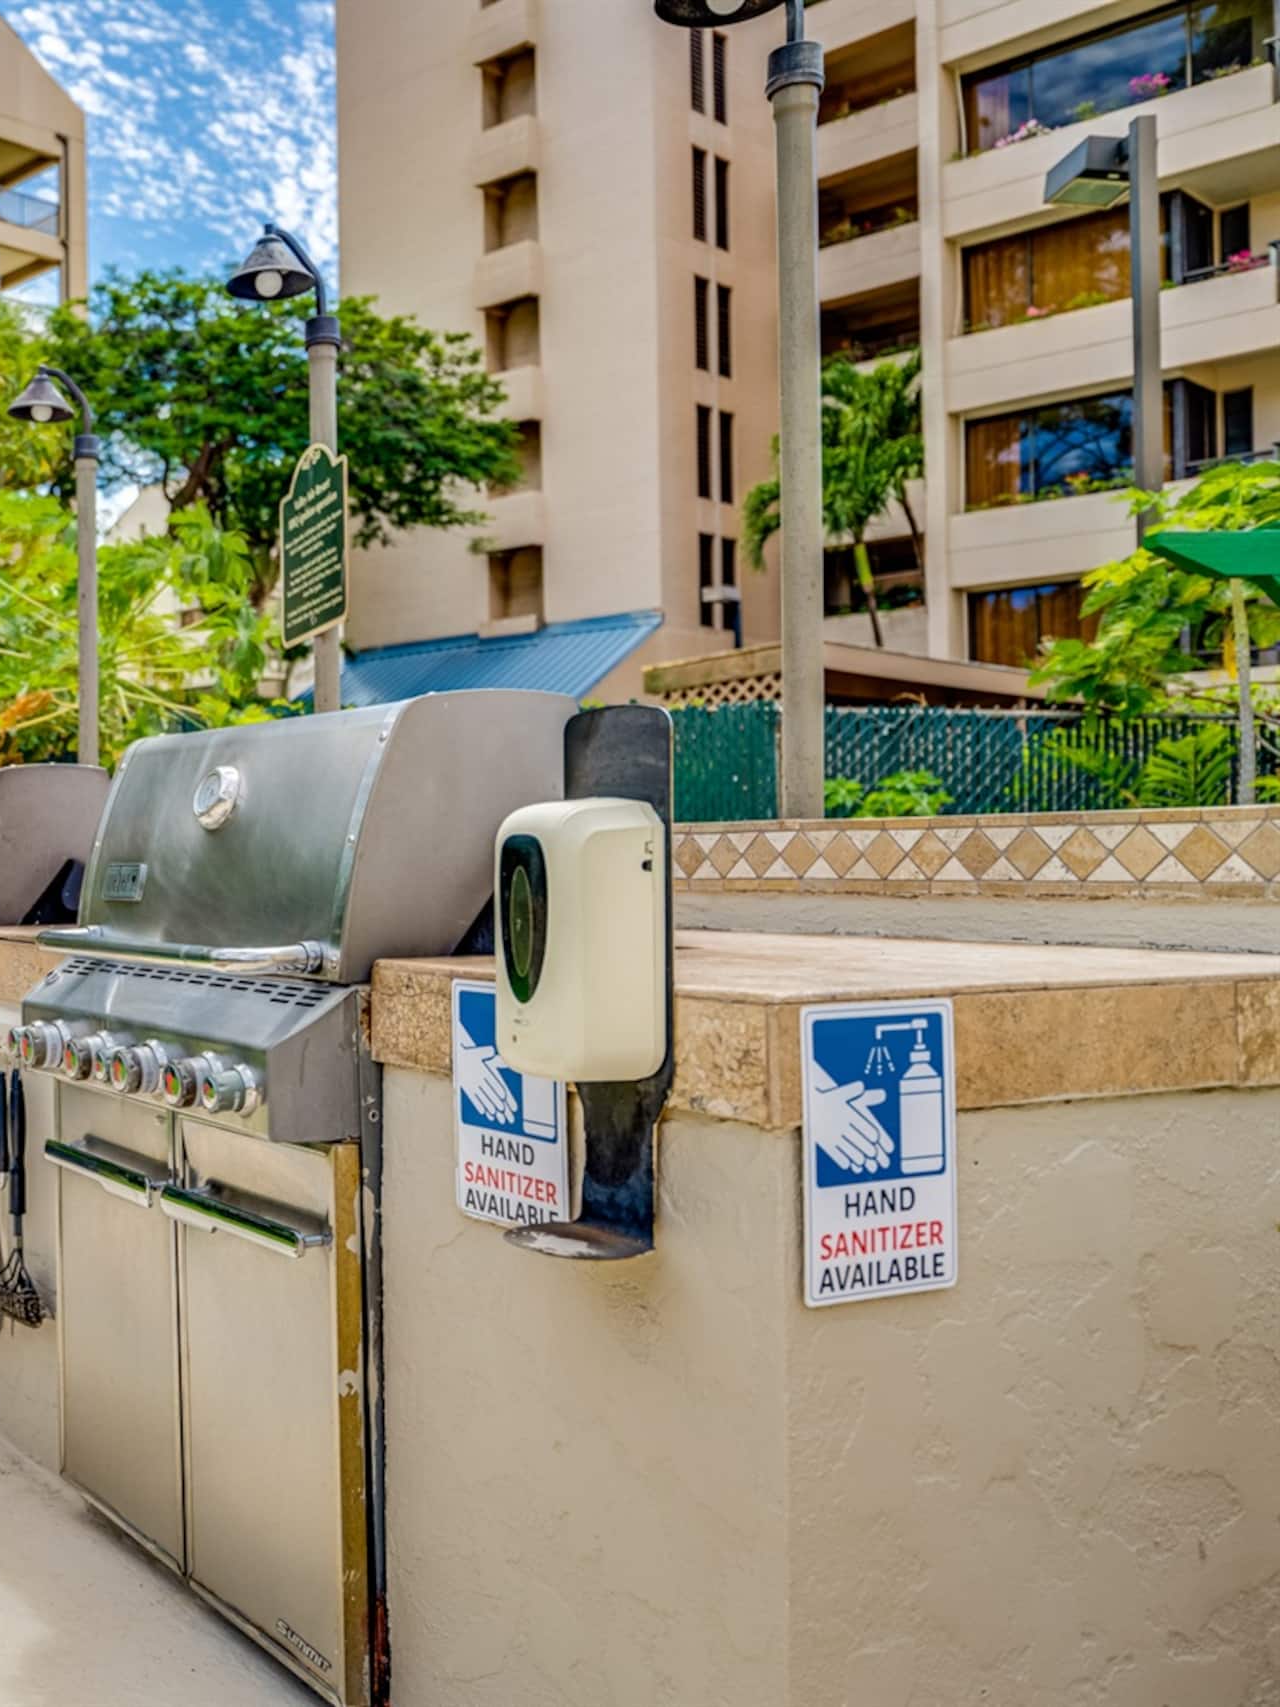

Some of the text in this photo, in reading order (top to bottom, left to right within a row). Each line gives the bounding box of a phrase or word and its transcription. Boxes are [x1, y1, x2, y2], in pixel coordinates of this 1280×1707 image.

[481, 1134, 534, 1165] HAND
[465, 1162, 557, 1204] SANITIZER
[844, 1186, 916, 1218] HAND
[820, 1220, 944, 1261] SANITIZER
[819, 1252, 945, 1295] AVAILABLE
